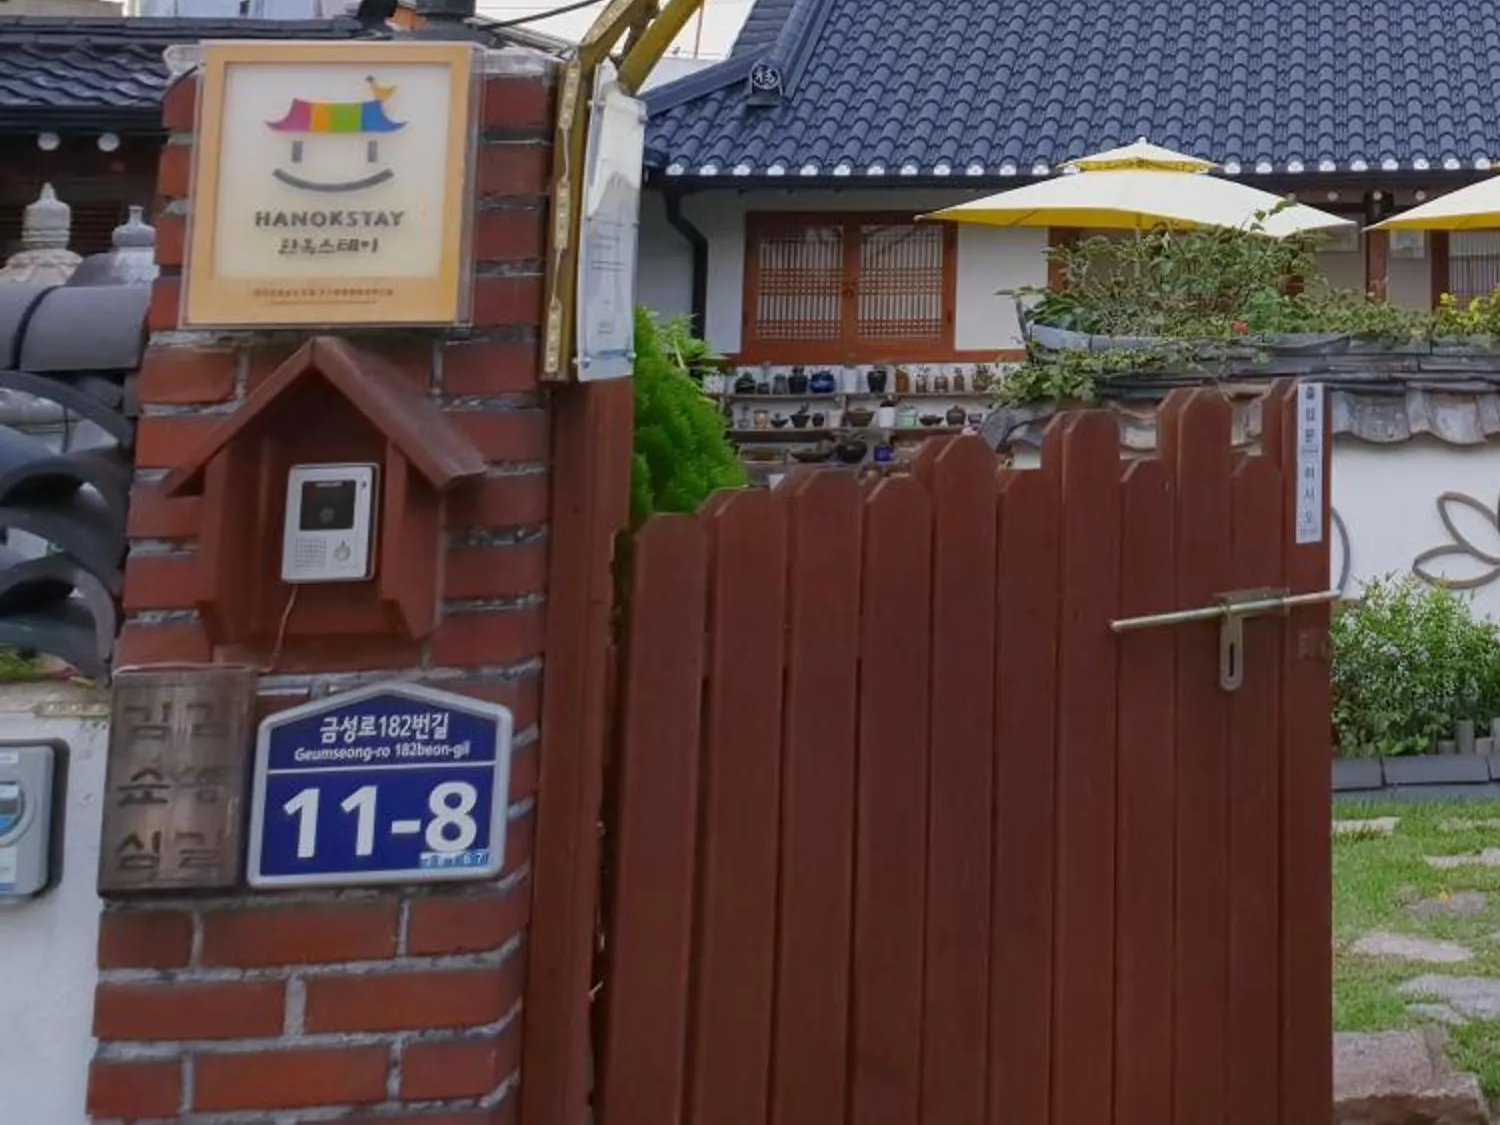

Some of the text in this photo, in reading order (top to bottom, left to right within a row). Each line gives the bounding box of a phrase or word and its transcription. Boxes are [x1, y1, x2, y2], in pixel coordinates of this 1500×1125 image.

[254, 210, 404, 228] HANOKSTAY
[278, 237, 379, 256] 한옥스테이
[319, 712, 450, 744] 금성로182번길
[294, 740, 471, 763] Geumseong-ro 182beon-gil
[283, 780, 478, 859] 11-8
